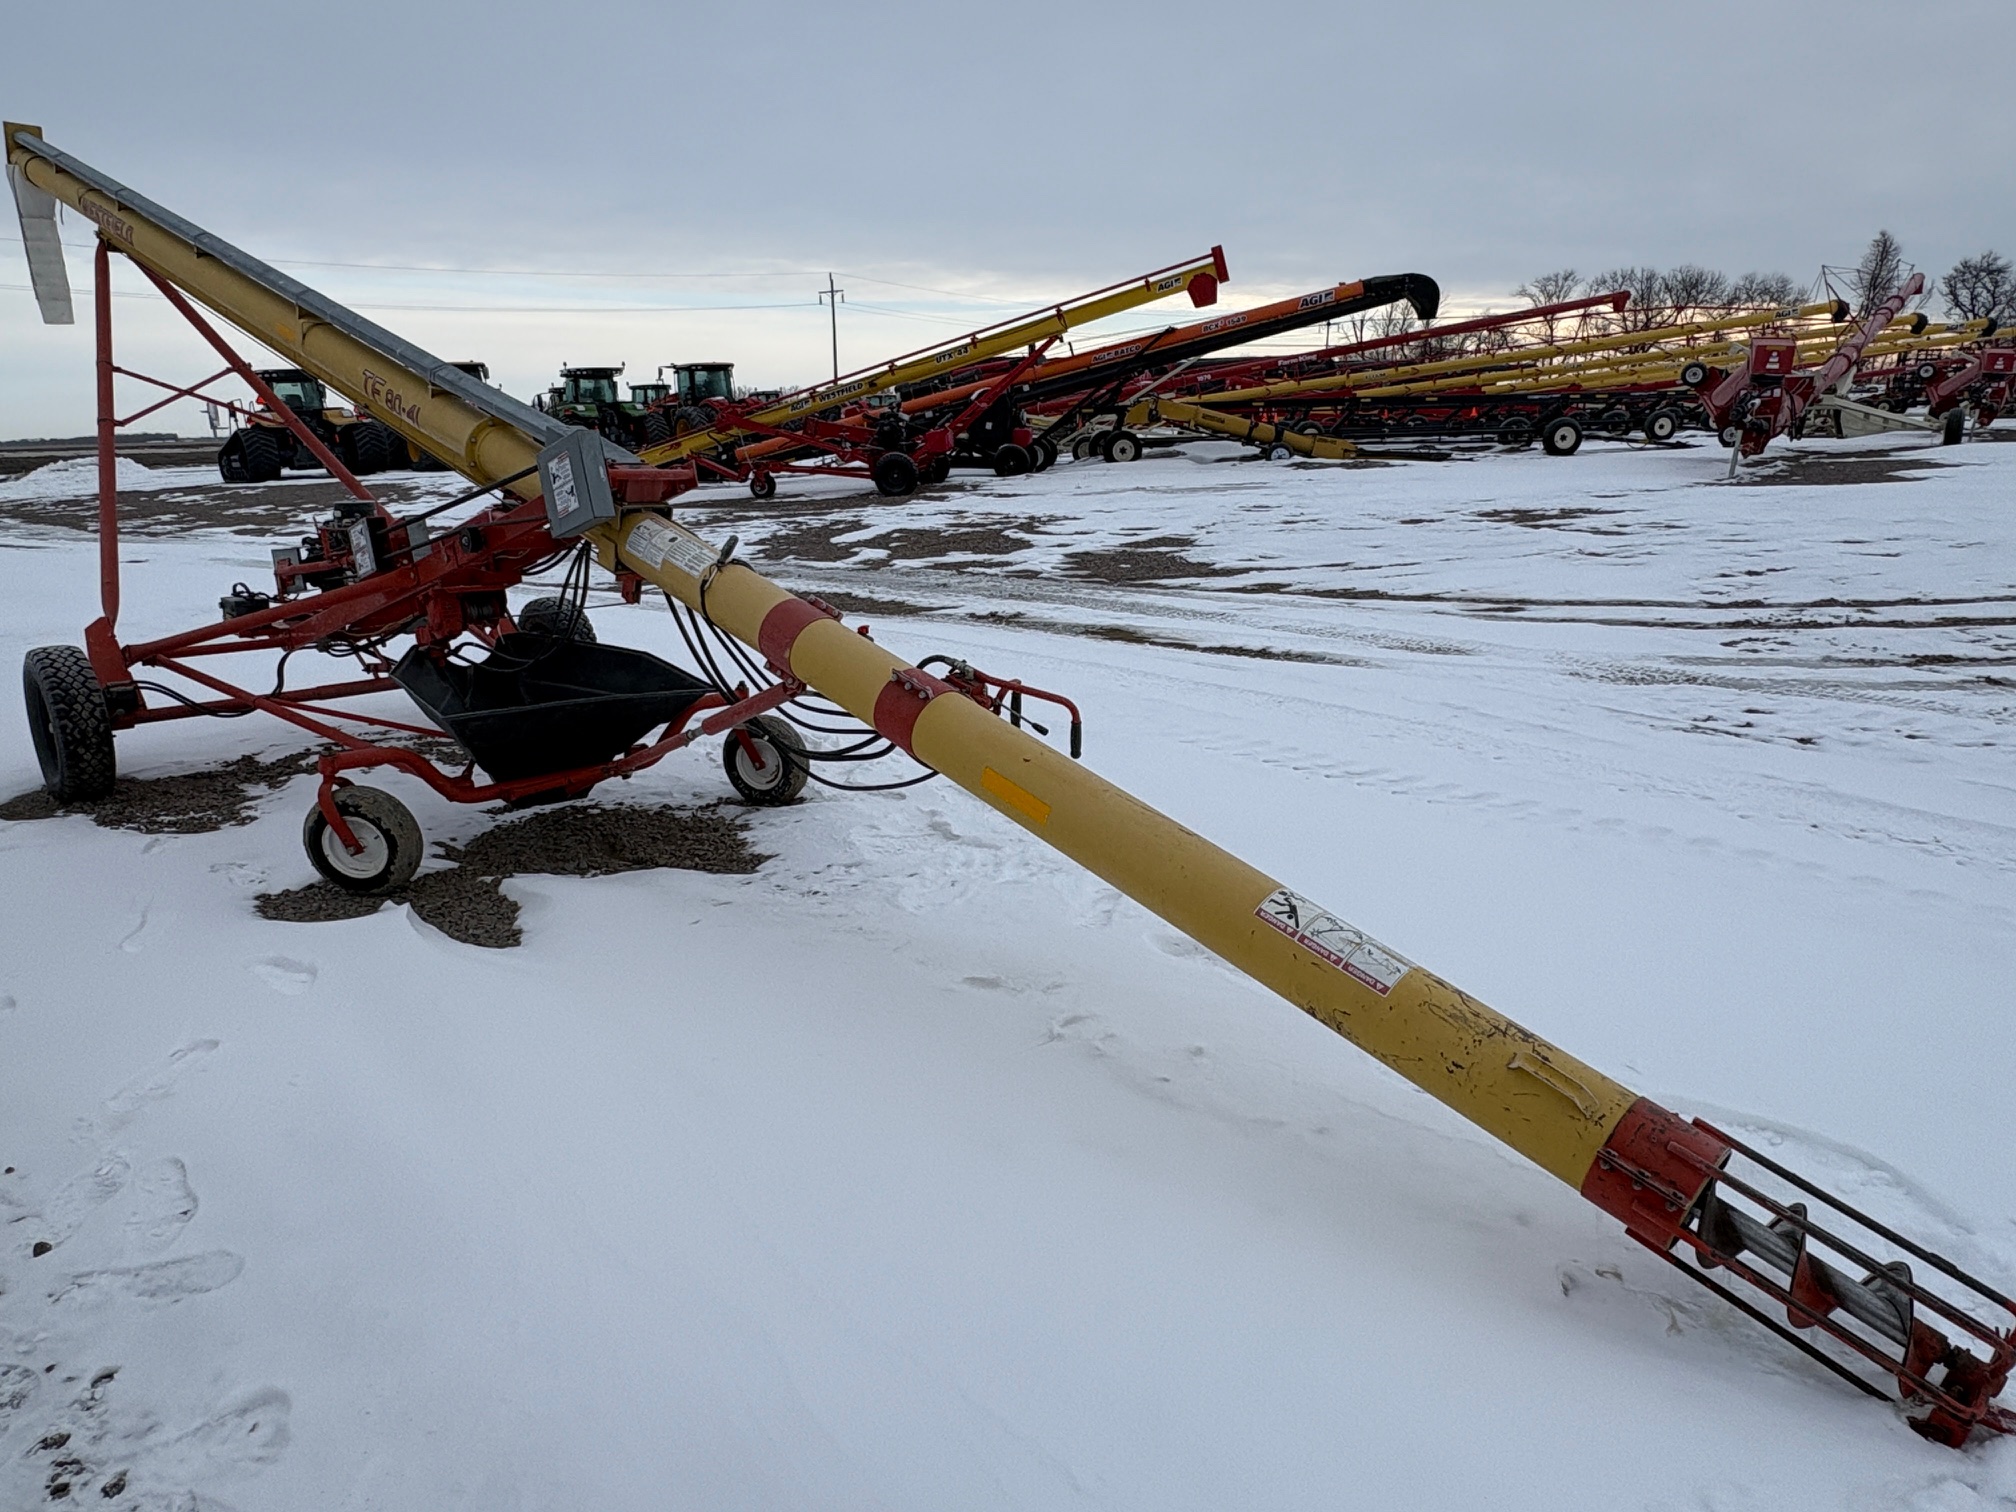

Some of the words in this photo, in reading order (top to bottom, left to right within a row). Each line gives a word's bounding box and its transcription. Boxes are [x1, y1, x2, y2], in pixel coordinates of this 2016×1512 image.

[1158, 280, 1174, 292] AGI
[1300, 293, 1323, 308] AGI
[935, 352, 954, 364] UTX
[819, 383, 864, 403] WESTFIELD
[1260, 910, 1286, 930] DANGER
[1303, 937, 1330, 958] DANGER
[1348, 964, 1376, 986] DANGER
